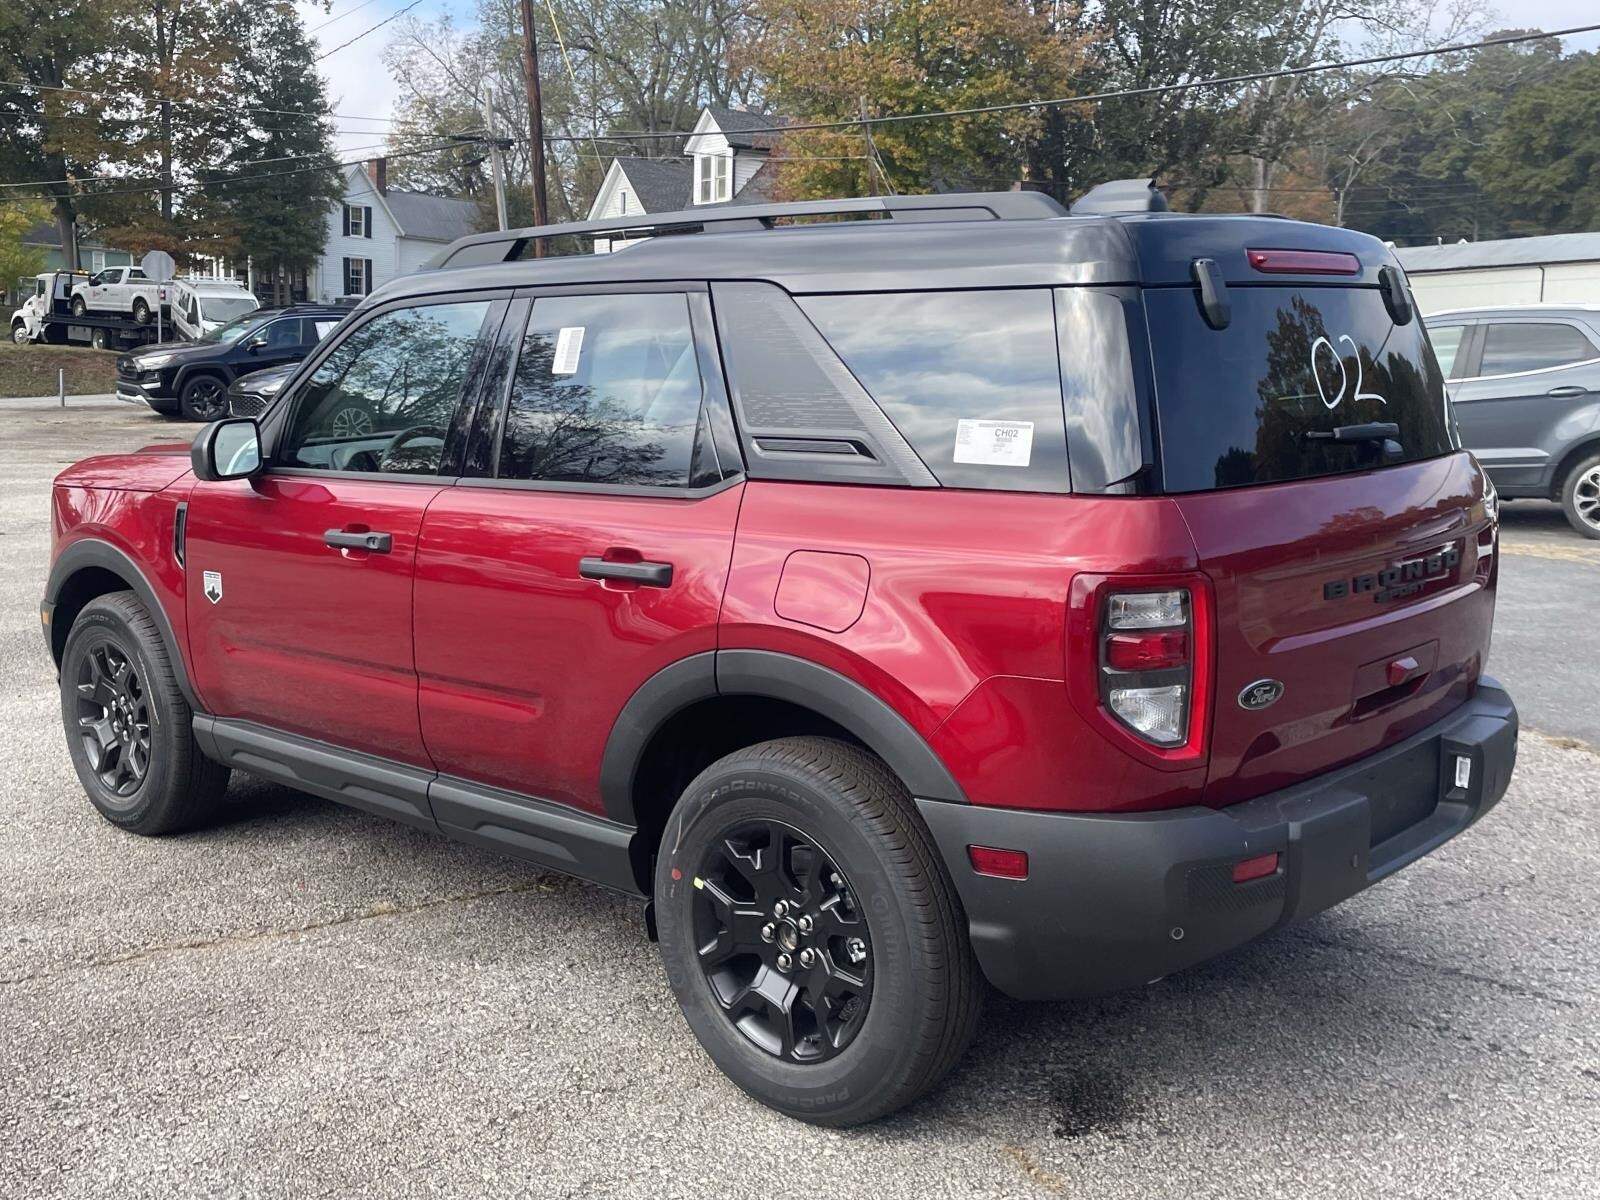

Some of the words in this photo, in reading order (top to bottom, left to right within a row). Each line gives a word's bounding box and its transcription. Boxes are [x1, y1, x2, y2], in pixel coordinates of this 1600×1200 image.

[1311, 335, 1387, 409] 02
[994, 428, 1019, 438] CH02
[1324, 549, 1459, 600] BRONCO
